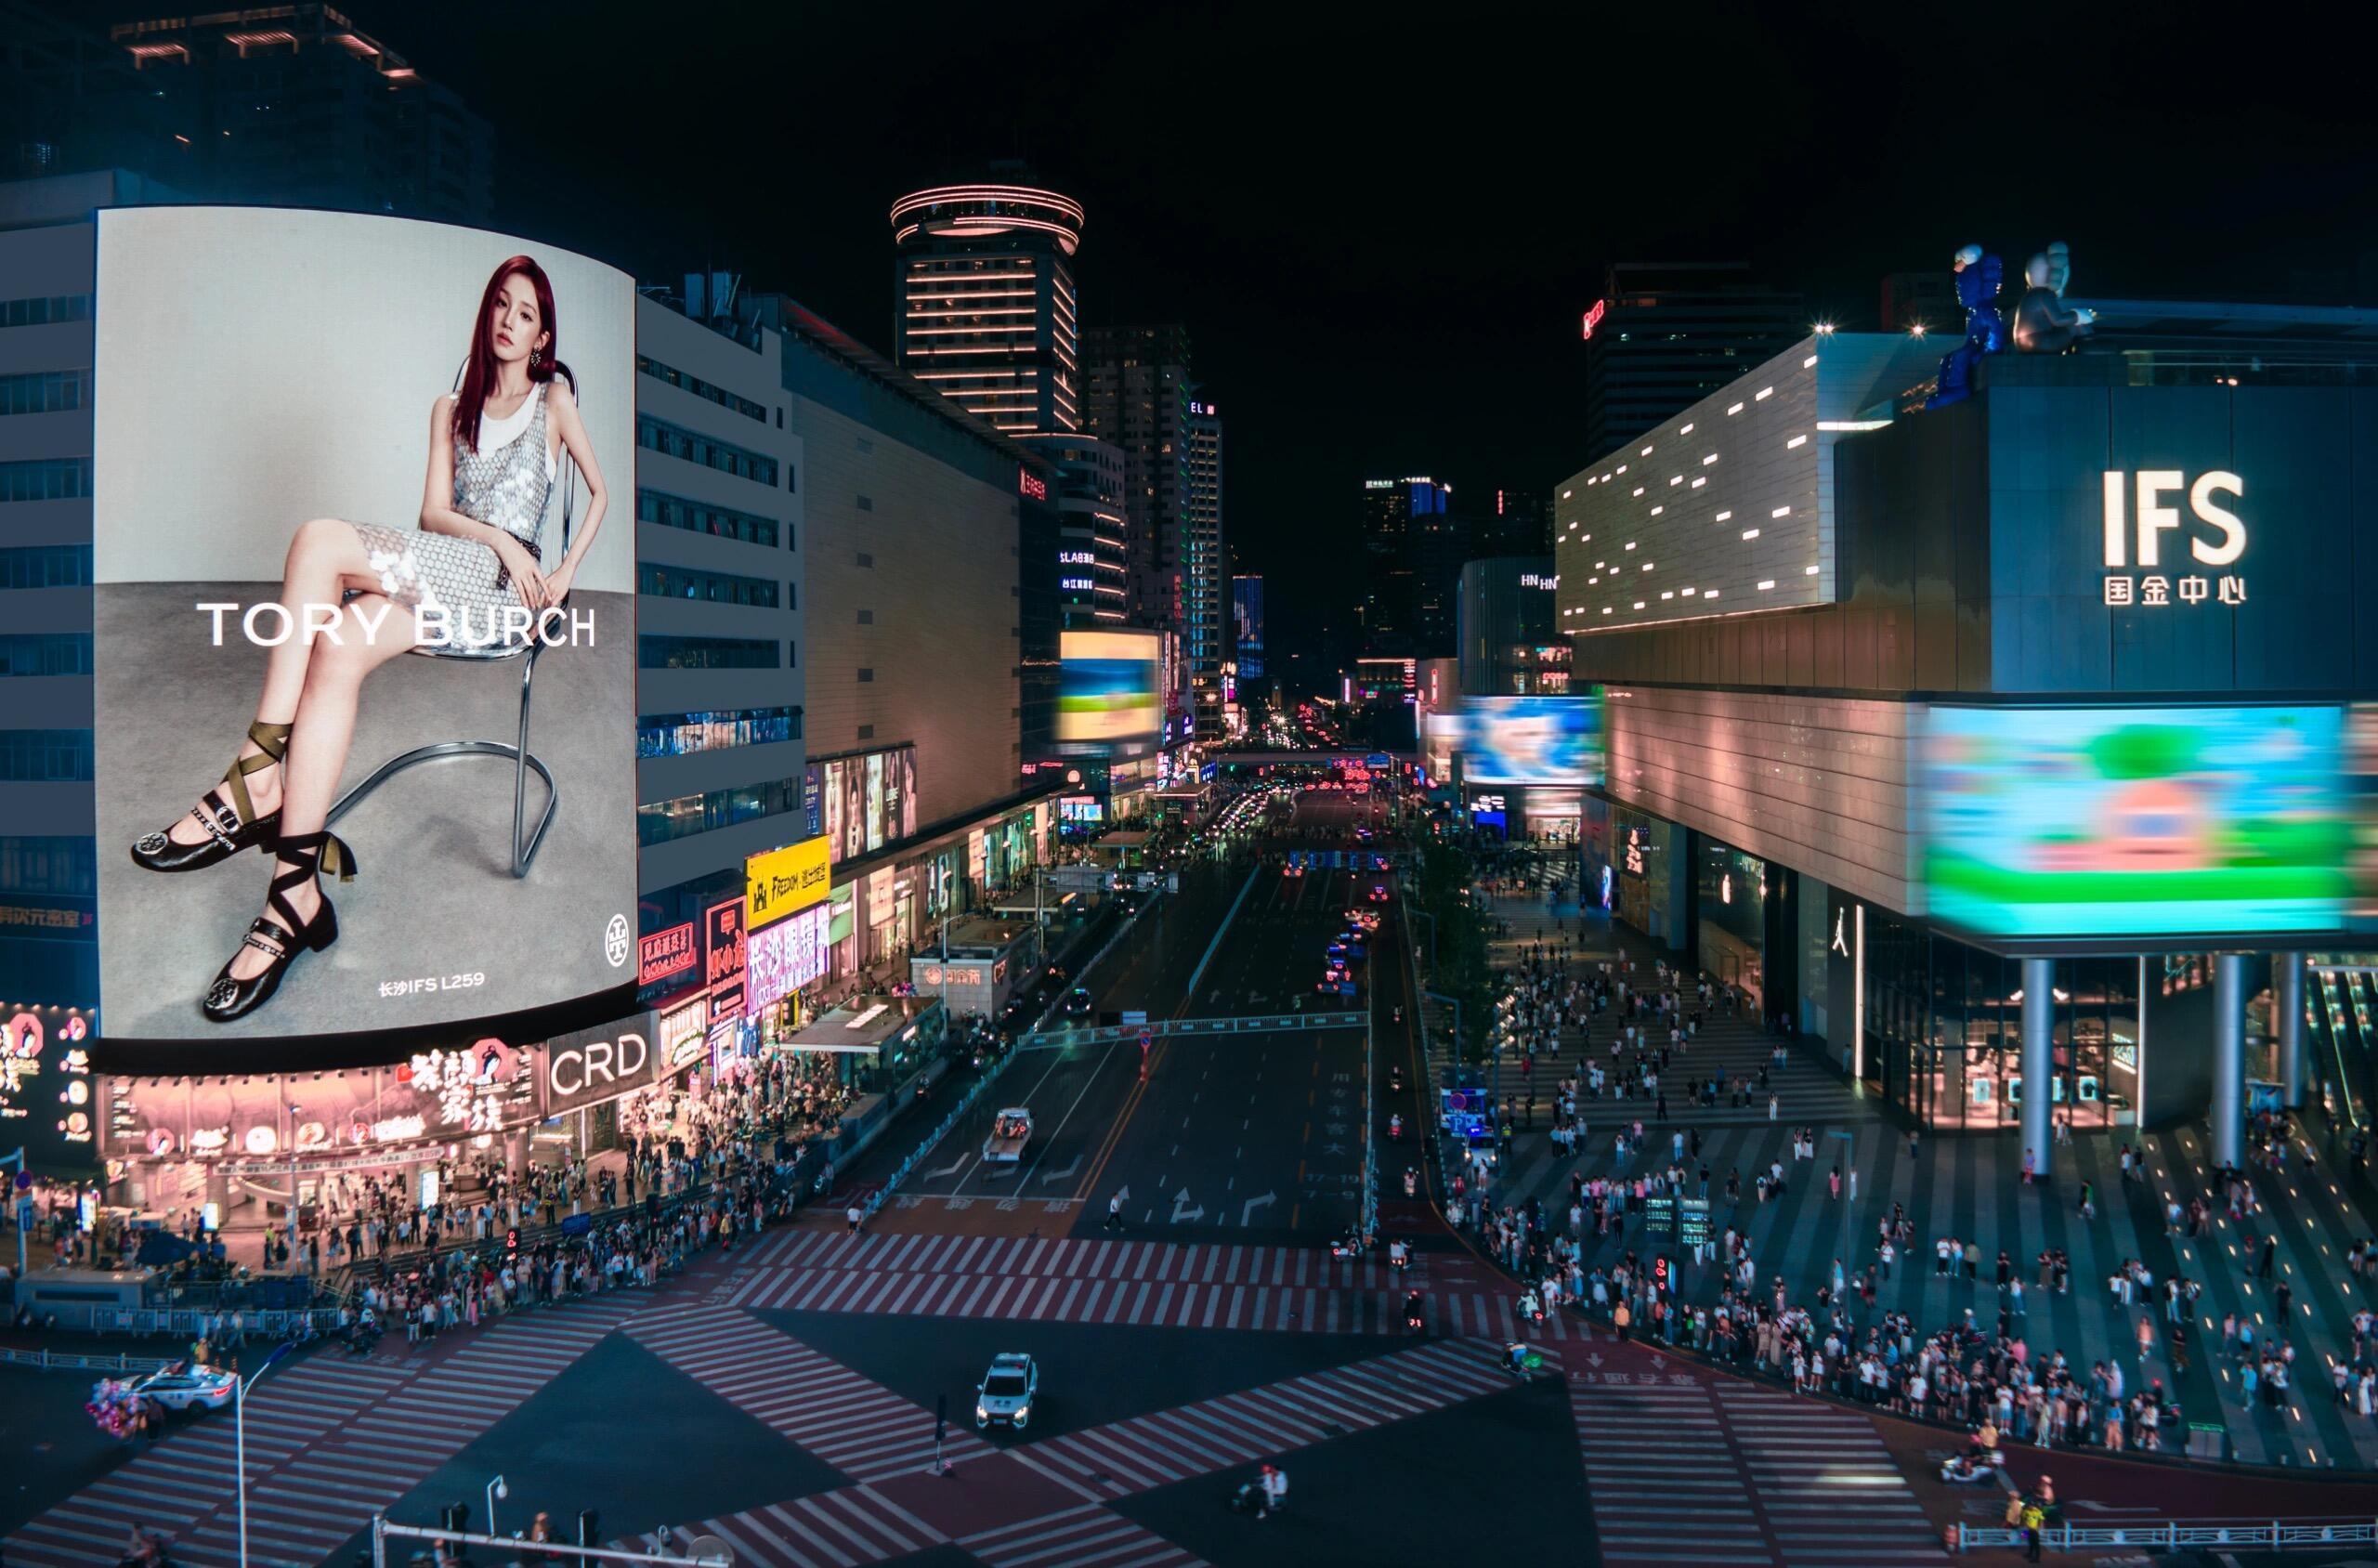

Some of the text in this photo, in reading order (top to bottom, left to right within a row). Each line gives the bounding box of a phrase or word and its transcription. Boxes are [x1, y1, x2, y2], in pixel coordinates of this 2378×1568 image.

[2103, 470, 2247, 567] IFS
[2103, 574, 2247, 606] 国金中心
[196, 602, 595, 647] TORY BURCH
[378, 972, 485, 998] 长沙IFS L259
[551, 1033, 647, 1096] CRD
